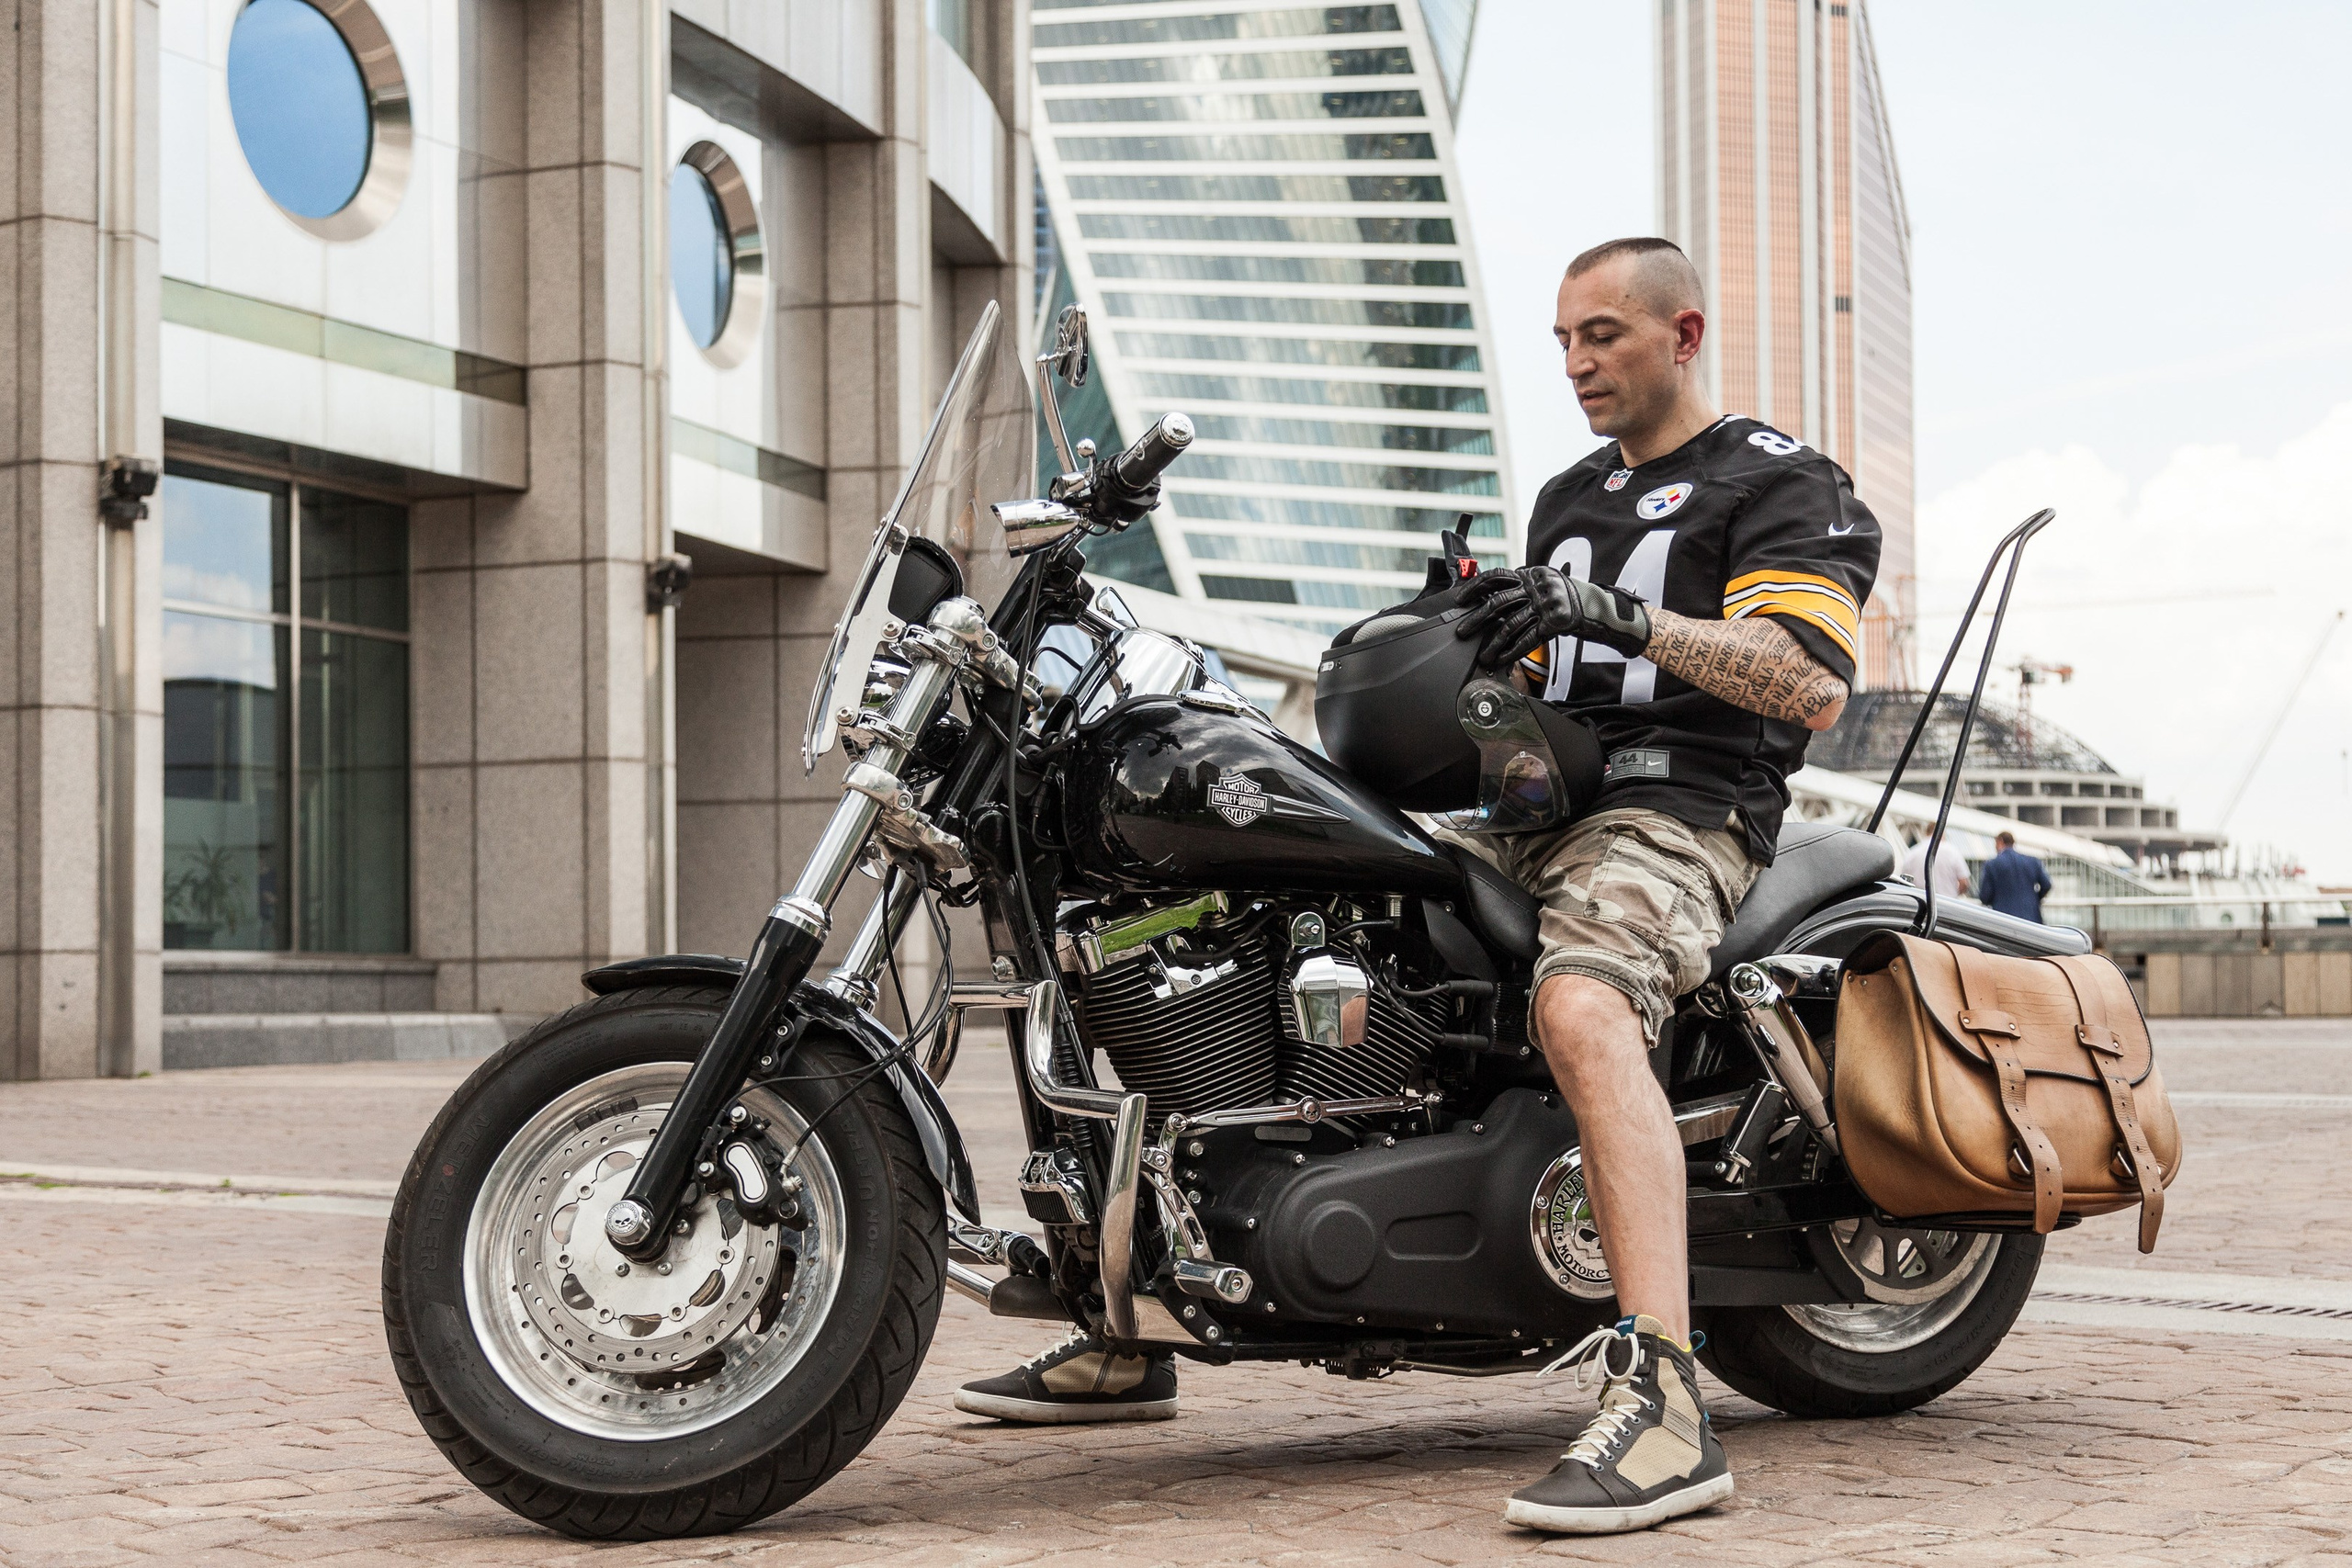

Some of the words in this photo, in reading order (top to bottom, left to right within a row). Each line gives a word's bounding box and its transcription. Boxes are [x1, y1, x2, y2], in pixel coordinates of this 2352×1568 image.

[1608, 478, 1623, 488] NFL
[1619, 752, 1639, 764] 44
[1227, 780, 1255, 795] MOTOR
[1214, 791, 1265, 809] HARLEY-DAVIDSON
[1225, 807, 1252, 822] CYCLES
[420, 1110, 492, 1271] METZELER
